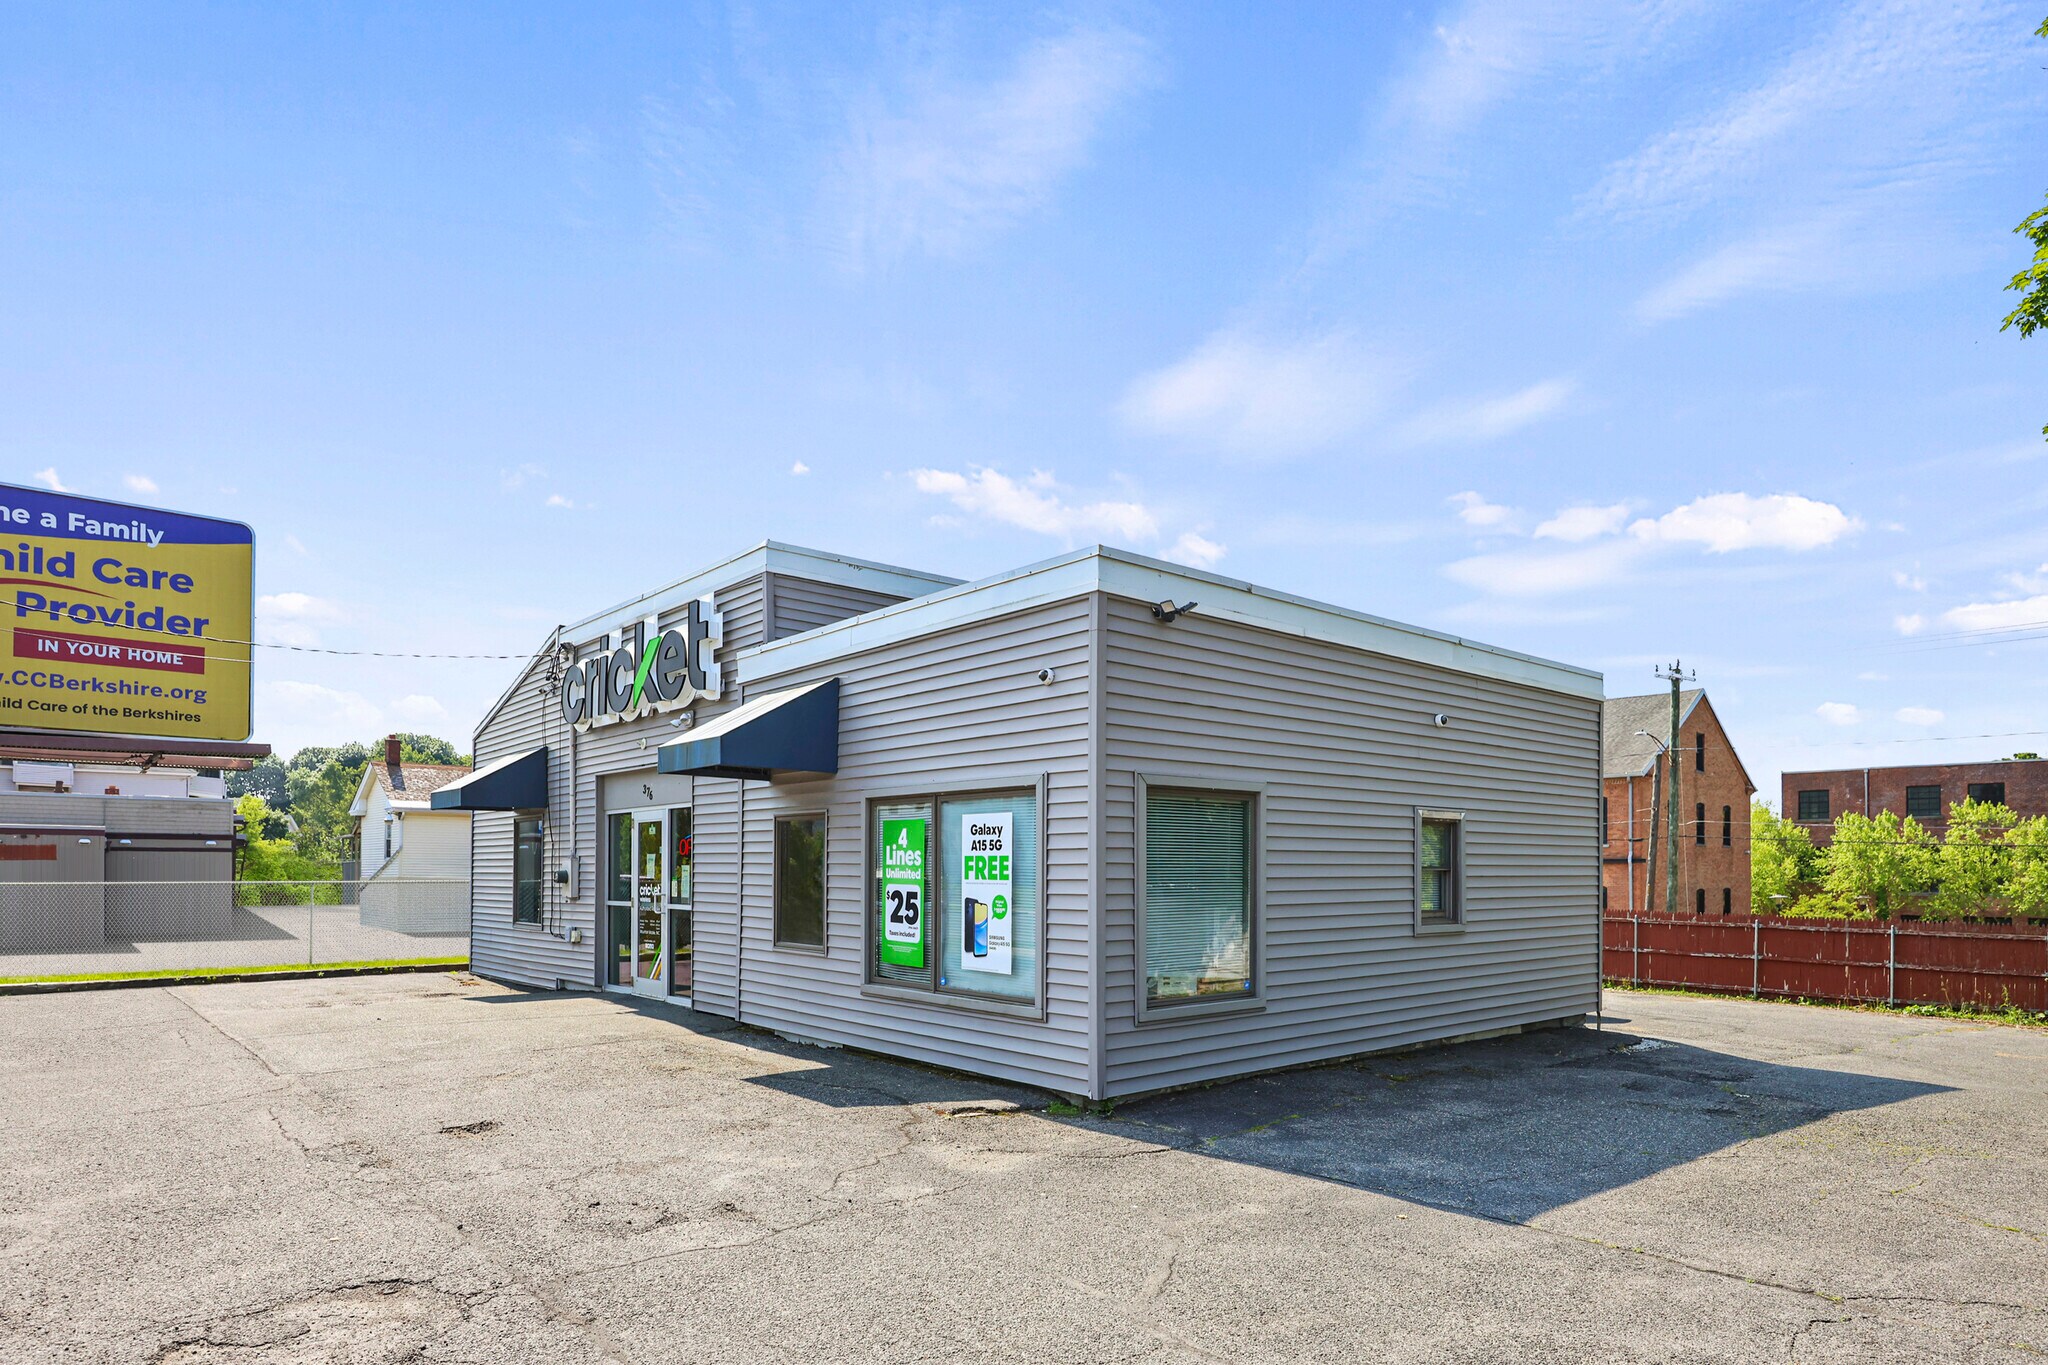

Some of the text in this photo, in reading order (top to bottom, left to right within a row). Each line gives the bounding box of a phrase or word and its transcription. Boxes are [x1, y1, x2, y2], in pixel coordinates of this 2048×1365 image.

[40, 512, 57, 529] a
[68, 512, 164, 548] Family
[92, 558, 194, 593] Care
[16, 590, 209, 637] Provider
[38, 639, 184, 665] IN YOUR HOME
[561, 599, 710, 725] cricket
[0, 696, 201, 722] ild Care of the Berkshires
[642, 784, 654, 800] 376
[898, 827, 908, 848] 4
[970, 823, 1003, 838] Galaxy
[886, 845, 922, 866] Lines
[971, 839, 1003, 851] A15 5G
[885, 868, 921, 880] Unlimited
[964, 855, 1010, 881] FREE
[886, 890, 919, 925] $25
